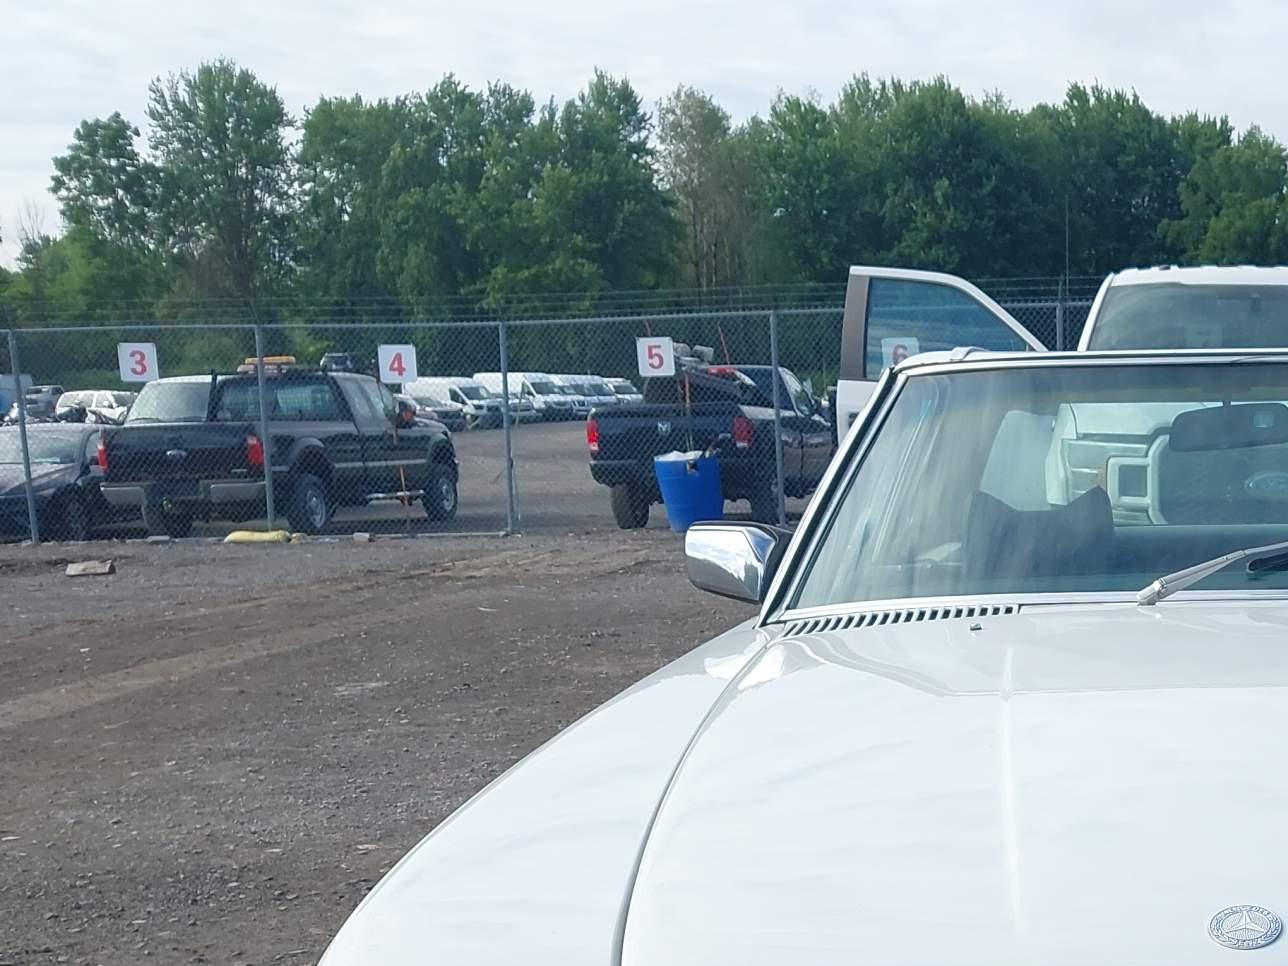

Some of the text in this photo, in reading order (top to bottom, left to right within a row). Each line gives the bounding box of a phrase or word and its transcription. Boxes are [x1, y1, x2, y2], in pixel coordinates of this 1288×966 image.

[129, 350, 147, 376] 3
[389, 351, 406, 376] 4
[647, 344, 664, 369] 5
[892, 344, 909, 366] 6
